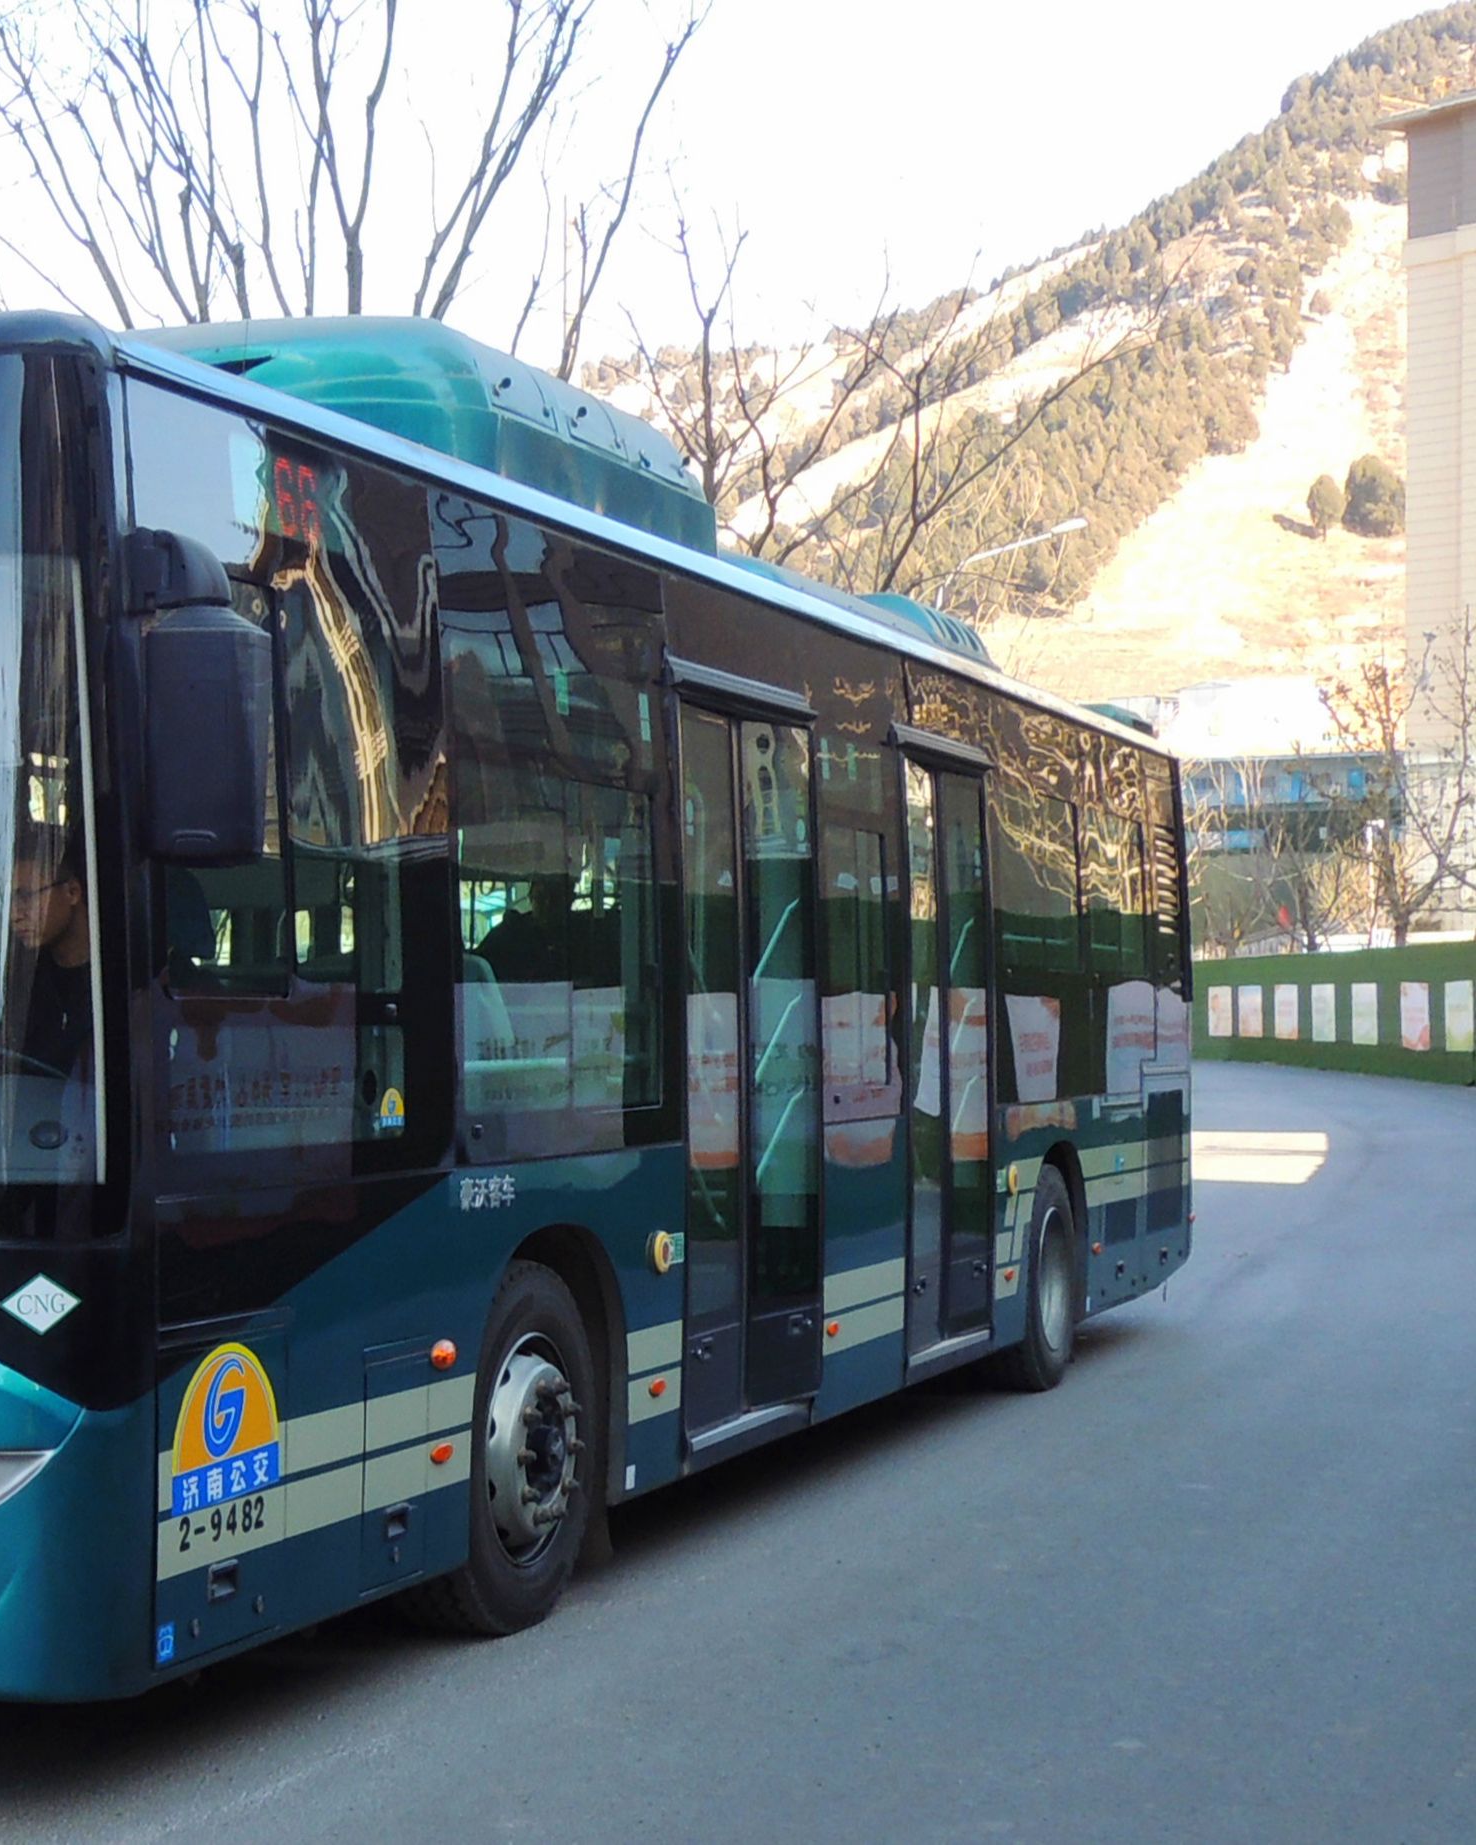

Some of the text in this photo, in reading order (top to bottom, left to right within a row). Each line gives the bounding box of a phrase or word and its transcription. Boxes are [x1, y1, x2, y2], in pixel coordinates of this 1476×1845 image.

[16, 1292, 66, 1315] CNG
[182, 1451, 269, 1513] 济南公交
[179, 1496, 265, 1553] 2-9482
